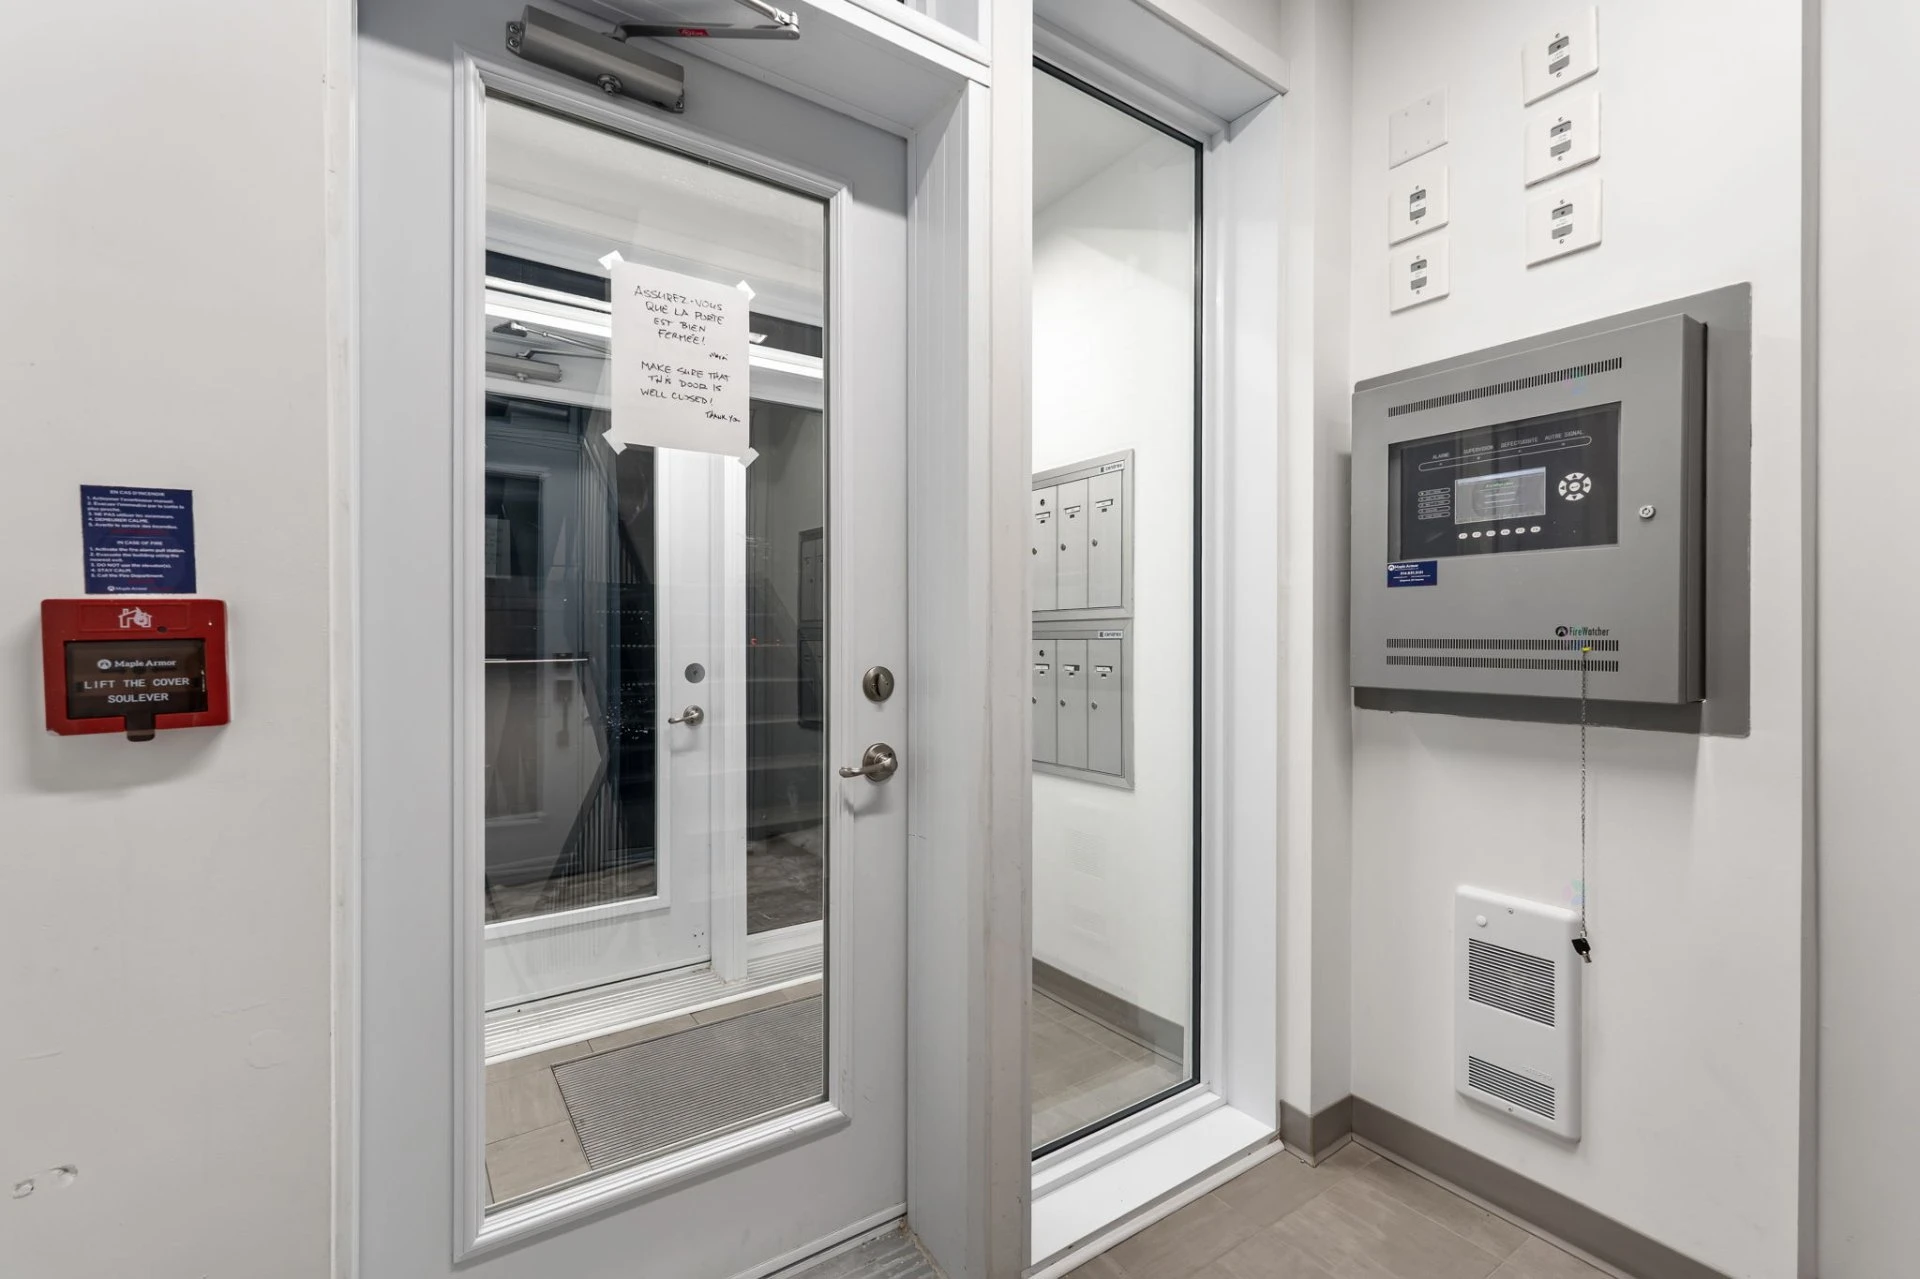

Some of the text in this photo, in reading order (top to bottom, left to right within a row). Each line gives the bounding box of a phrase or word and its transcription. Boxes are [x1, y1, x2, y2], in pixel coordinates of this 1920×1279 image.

[645, 301, 725, 325] QUE LA PORTE
[653, 317, 706, 332] EST BIEN
[641, 360, 730, 382] MAKE SURE THAT
[679, 379, 708, 390] DOOR
[713, 384, 722, 392] IS
[640, 388, 668, 399] WELL
[1544, 432, 1562, 441] AUTRE
[1564, 429, 1584, 439] SIGNAL
[1569, 626, 1610, 637] FireWatcher
[114, 659, 177, 669] Maple Armor
[84, 677, 190, 689] LIFT THE COVER
[107, 693, 169, 703] SOULEVER
